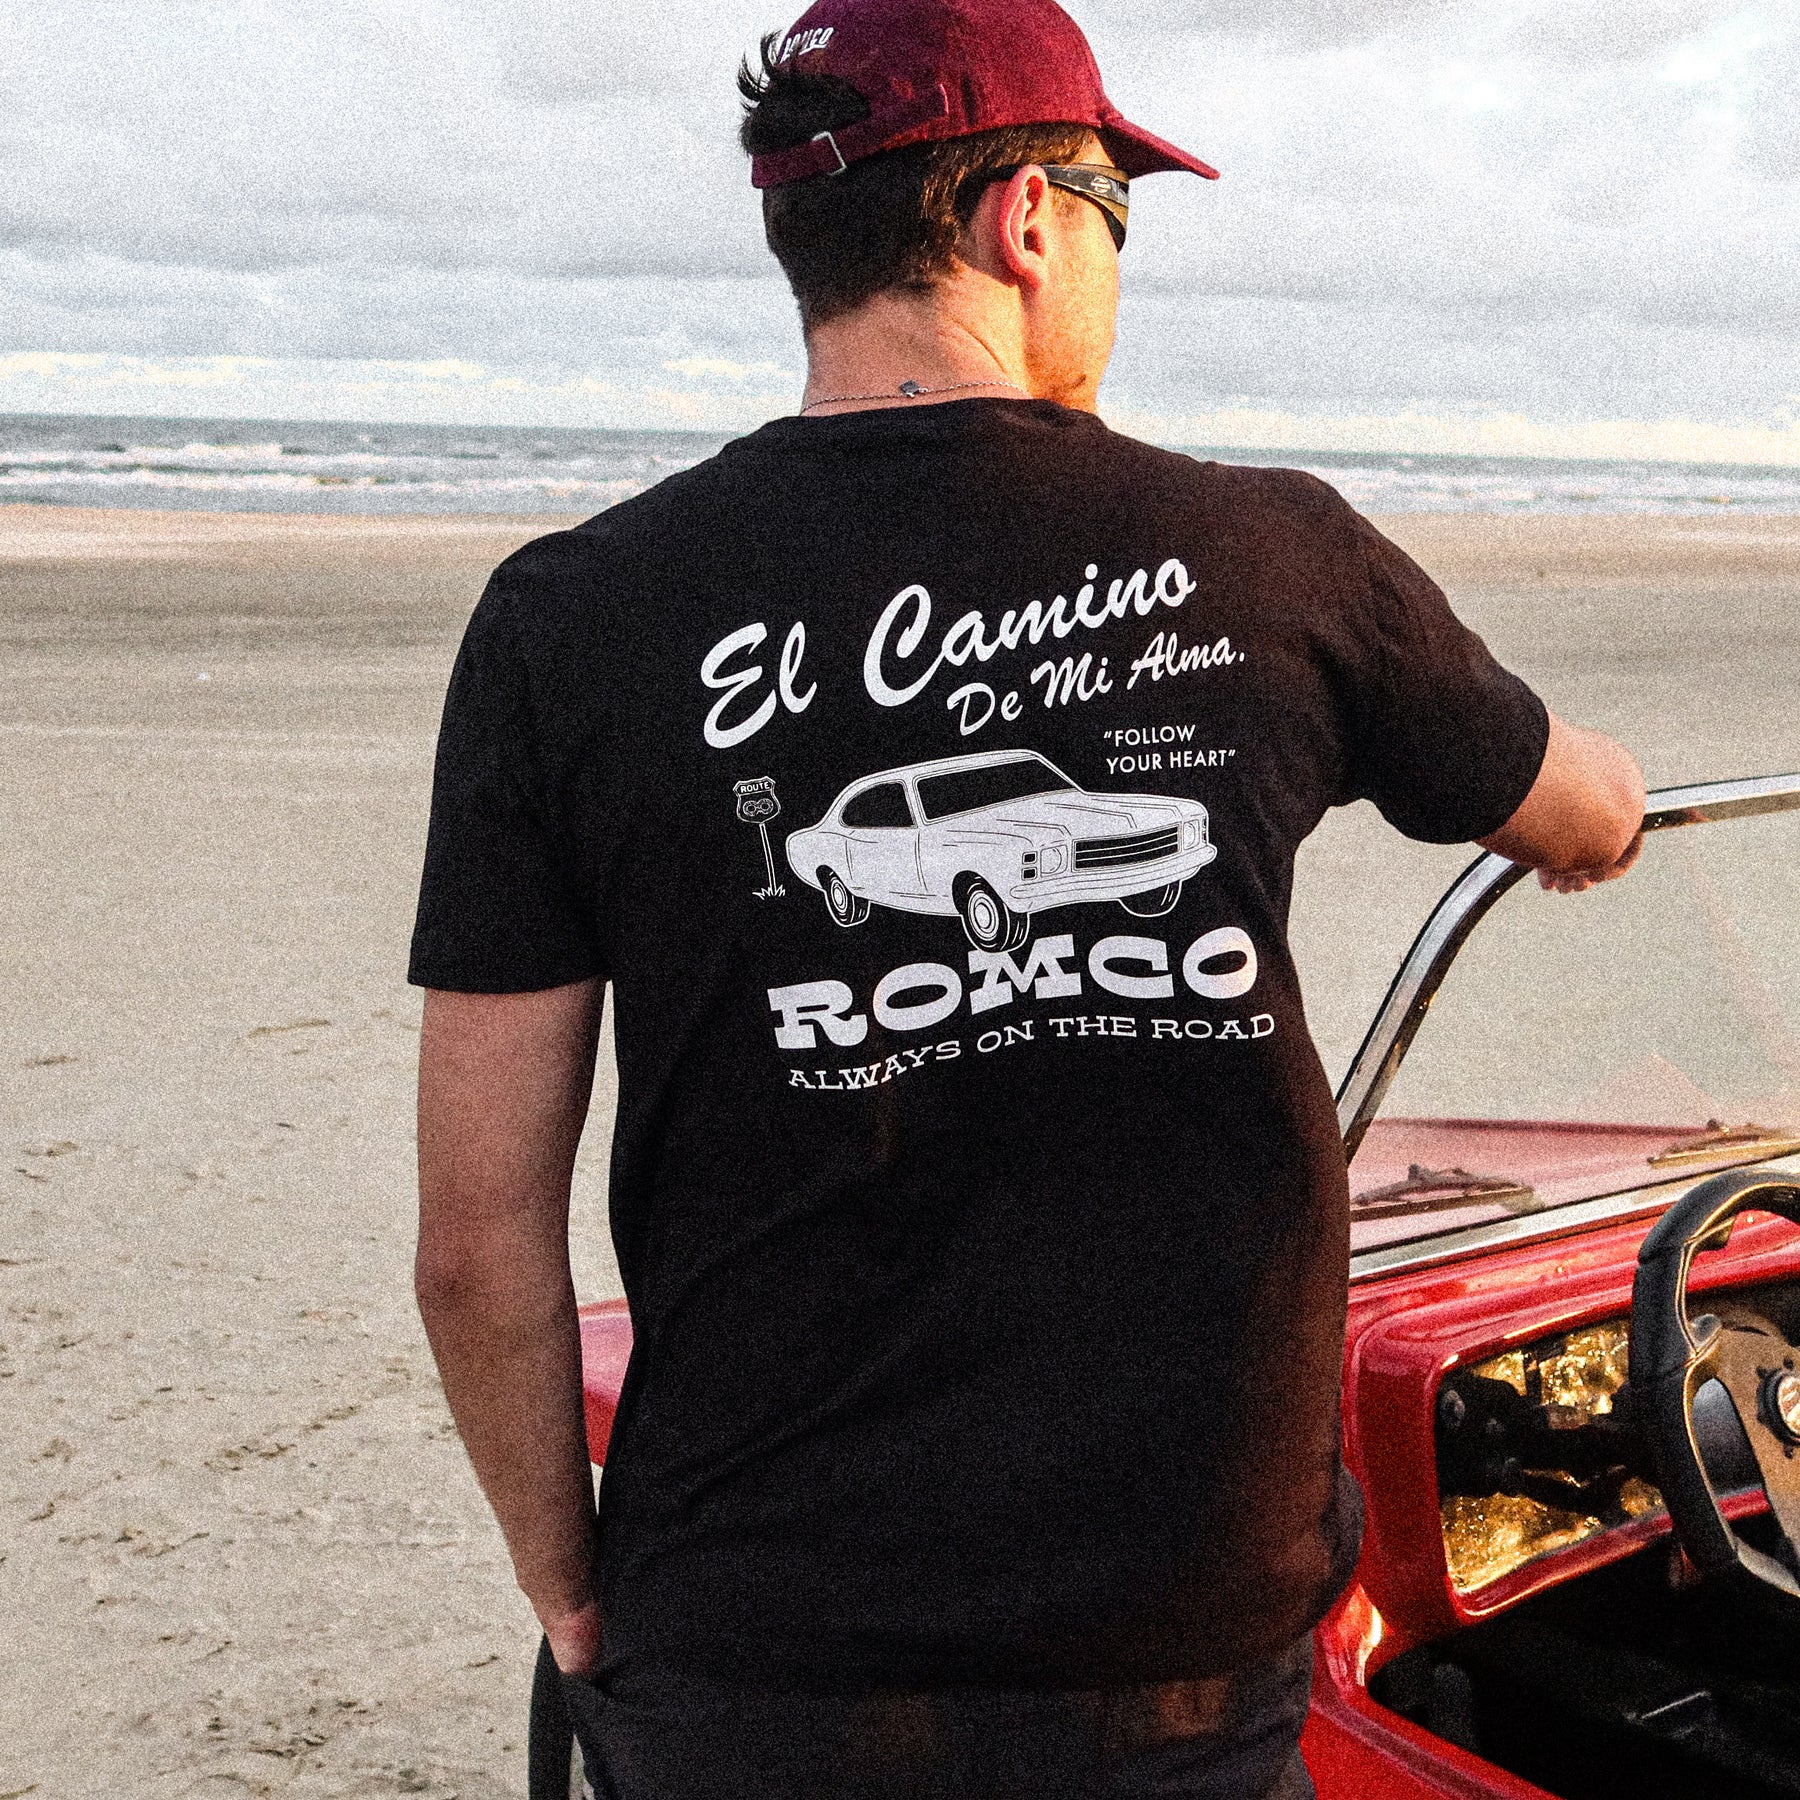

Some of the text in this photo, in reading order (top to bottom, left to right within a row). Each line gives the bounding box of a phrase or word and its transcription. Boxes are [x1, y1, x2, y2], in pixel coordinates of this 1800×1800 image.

[701, 558, 1196, 748] El Camino
[947, 632, 1245, 736] De Mi Alma.
[740, 781, 770, 793] ROUTE
[1106, 754, 1162, 775] YOUR
[767, 926, 1258, 1050] ROMCO
[788, 1013, 1275, 1090] ALWAYS ON THE ROAD
